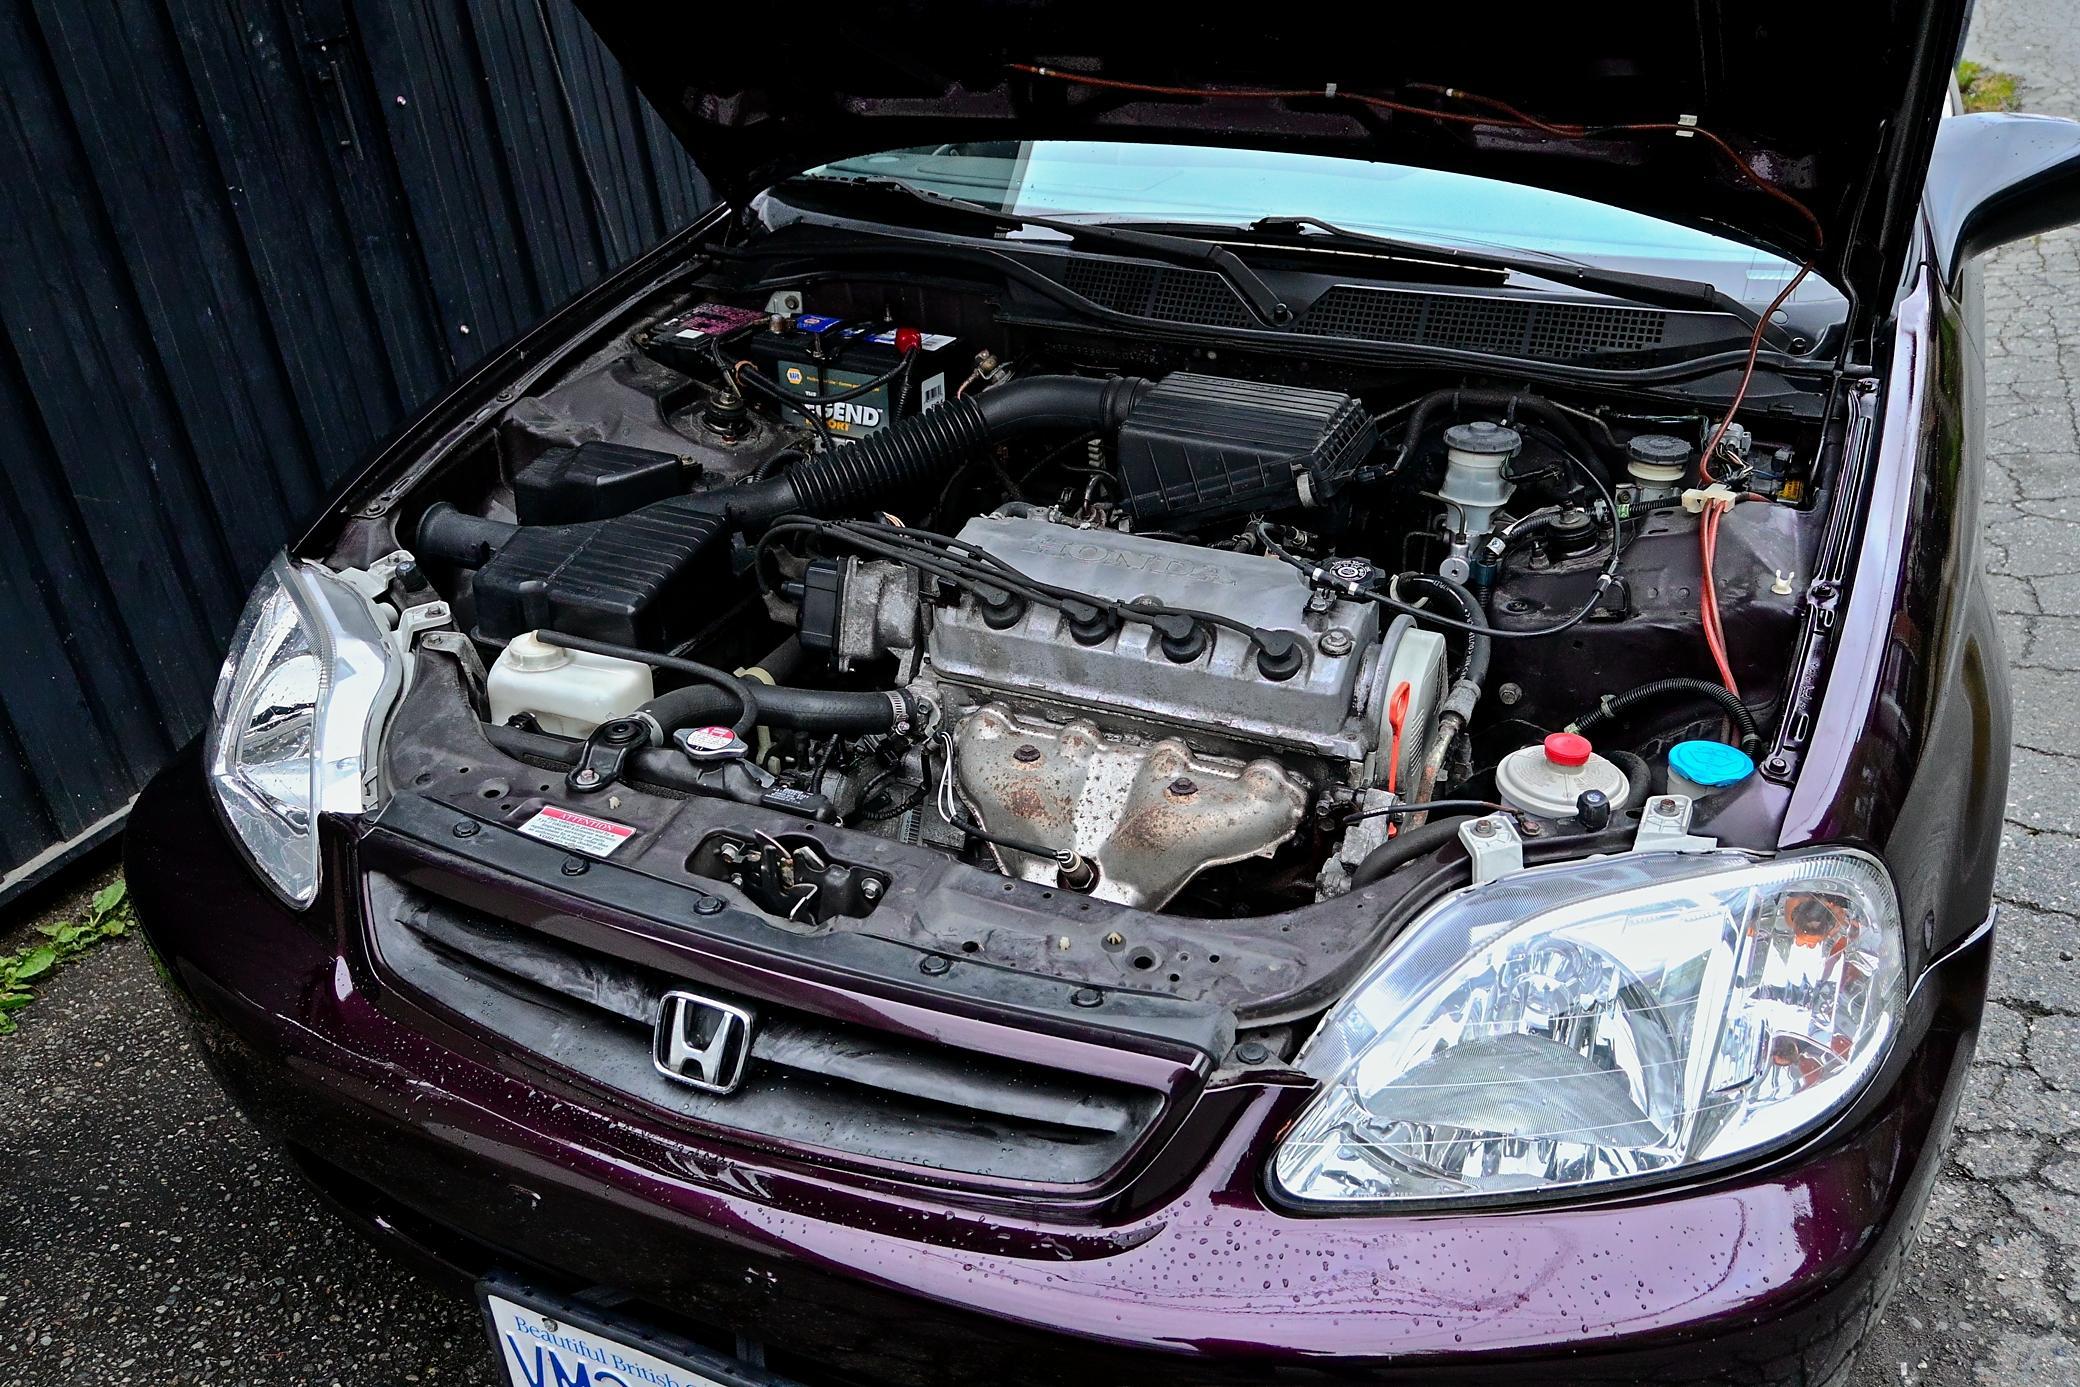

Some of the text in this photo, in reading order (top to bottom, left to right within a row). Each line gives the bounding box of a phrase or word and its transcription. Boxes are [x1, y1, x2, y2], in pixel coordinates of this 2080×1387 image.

[1020, 534, 1239, 586] HONDA
[559, 813, 615, 831] ATTENTION
[506, 1333, 633, 1387] VM
[514, 1315, 680, 1387] Beautiful British
